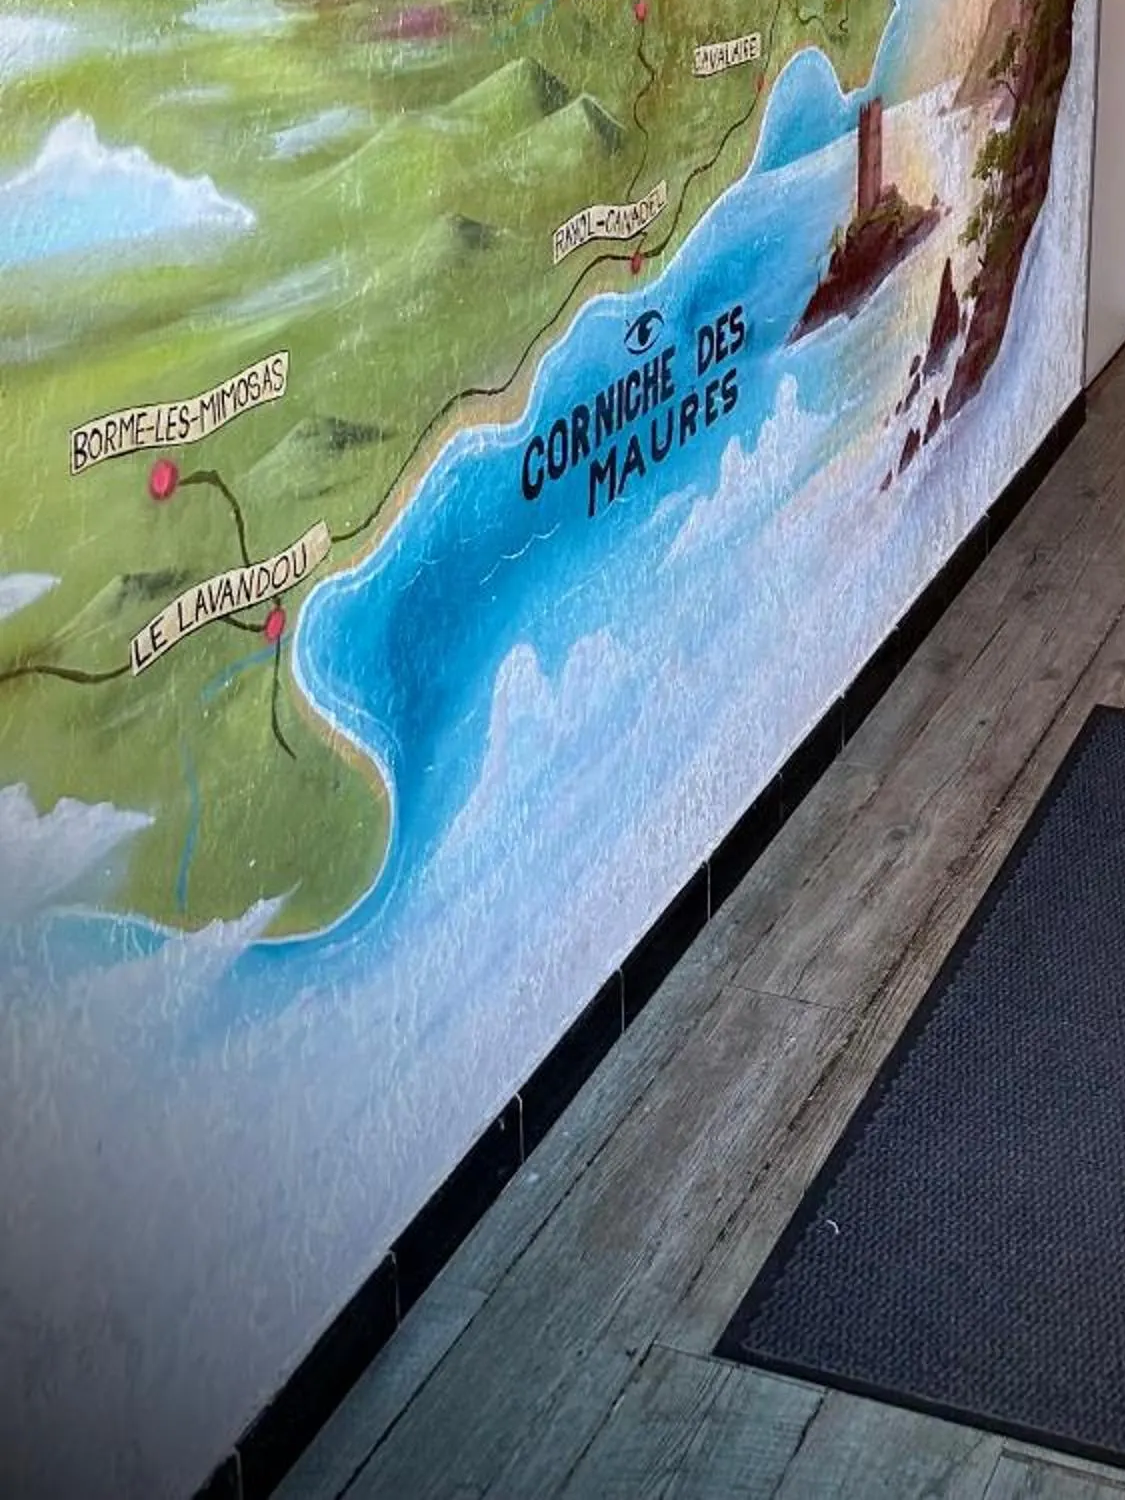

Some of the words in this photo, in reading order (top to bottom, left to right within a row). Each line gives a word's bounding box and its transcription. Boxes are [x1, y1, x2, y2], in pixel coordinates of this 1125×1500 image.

[73, 358, 284, 470] BORME-LES-MIMOSAS
[522, 345, 676, 501] CORNICHE
[696, 305, 746, 377] DES
[588, 368, 739, 518] MAURES
[134, 621, 168, 668] LE
[177, 543, 308, 632] LAVANDOU
